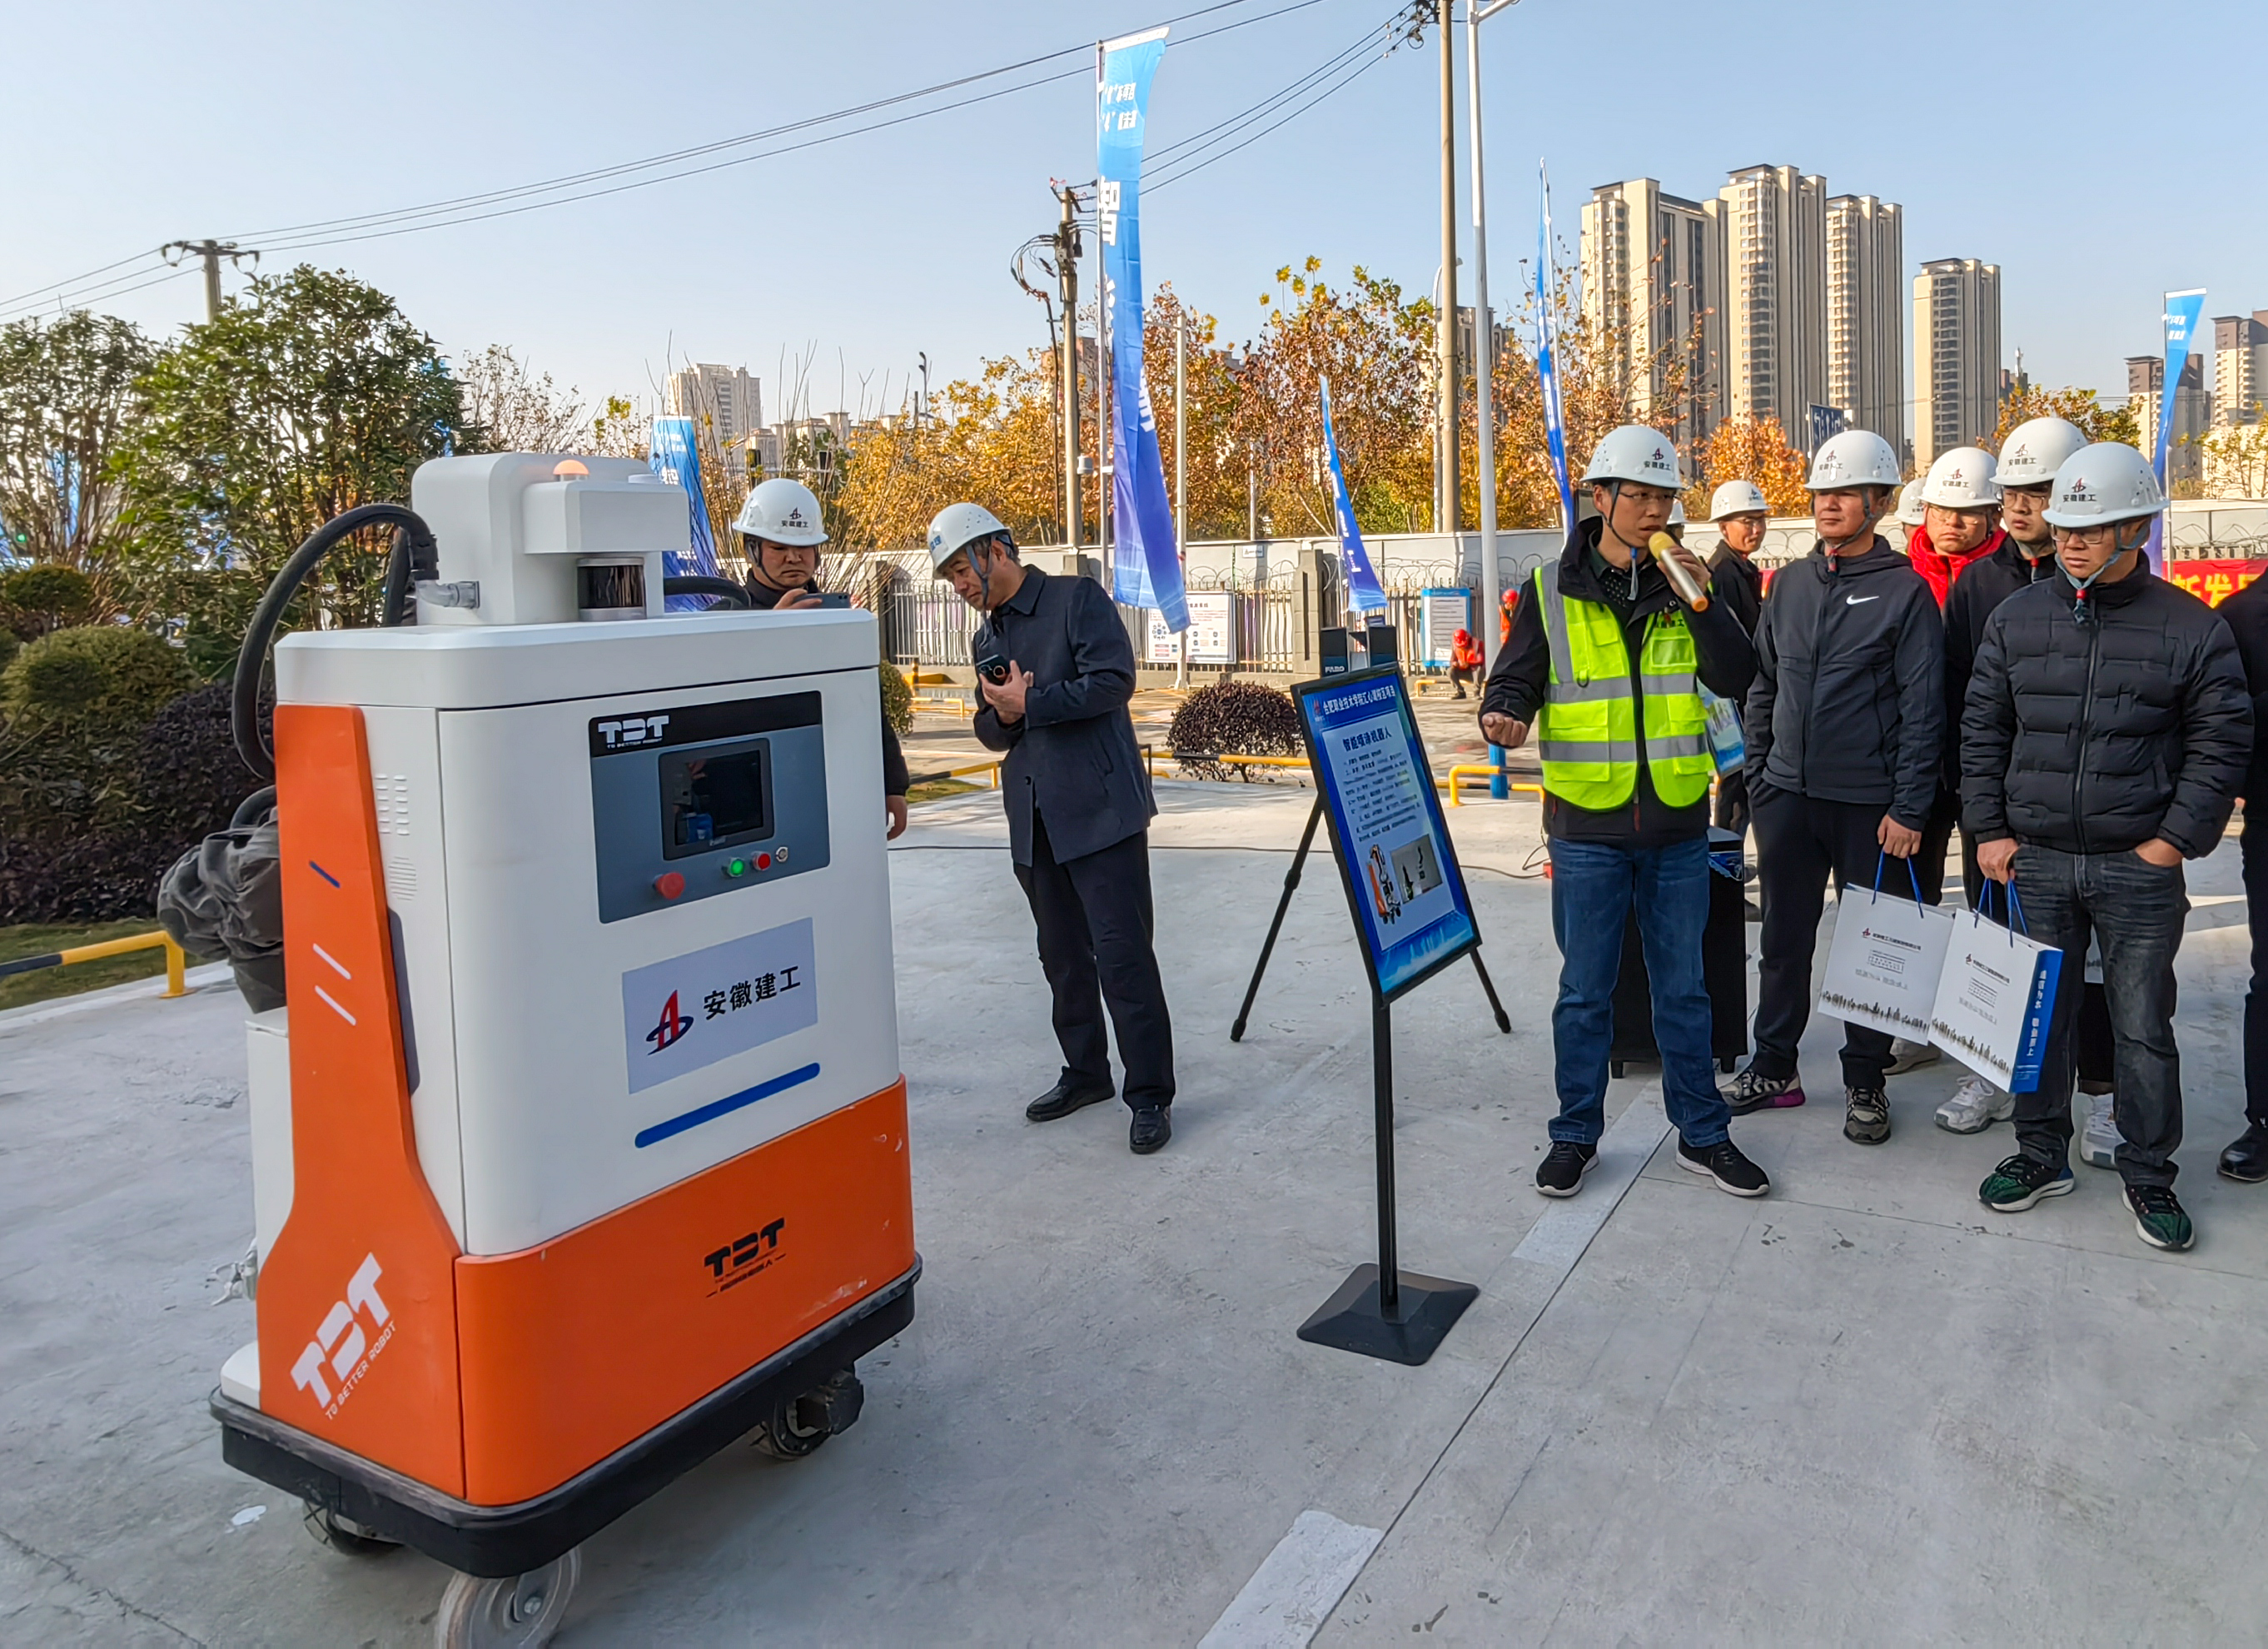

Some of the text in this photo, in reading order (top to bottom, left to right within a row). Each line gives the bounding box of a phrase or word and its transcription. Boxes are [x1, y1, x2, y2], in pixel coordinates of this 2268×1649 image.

[2062, 494, 2097, 502] 安徽建工
[703, 965, 802, 1021] 安徽建工
[326, 1320, 396, 1420] TO BETTER ROBOT
